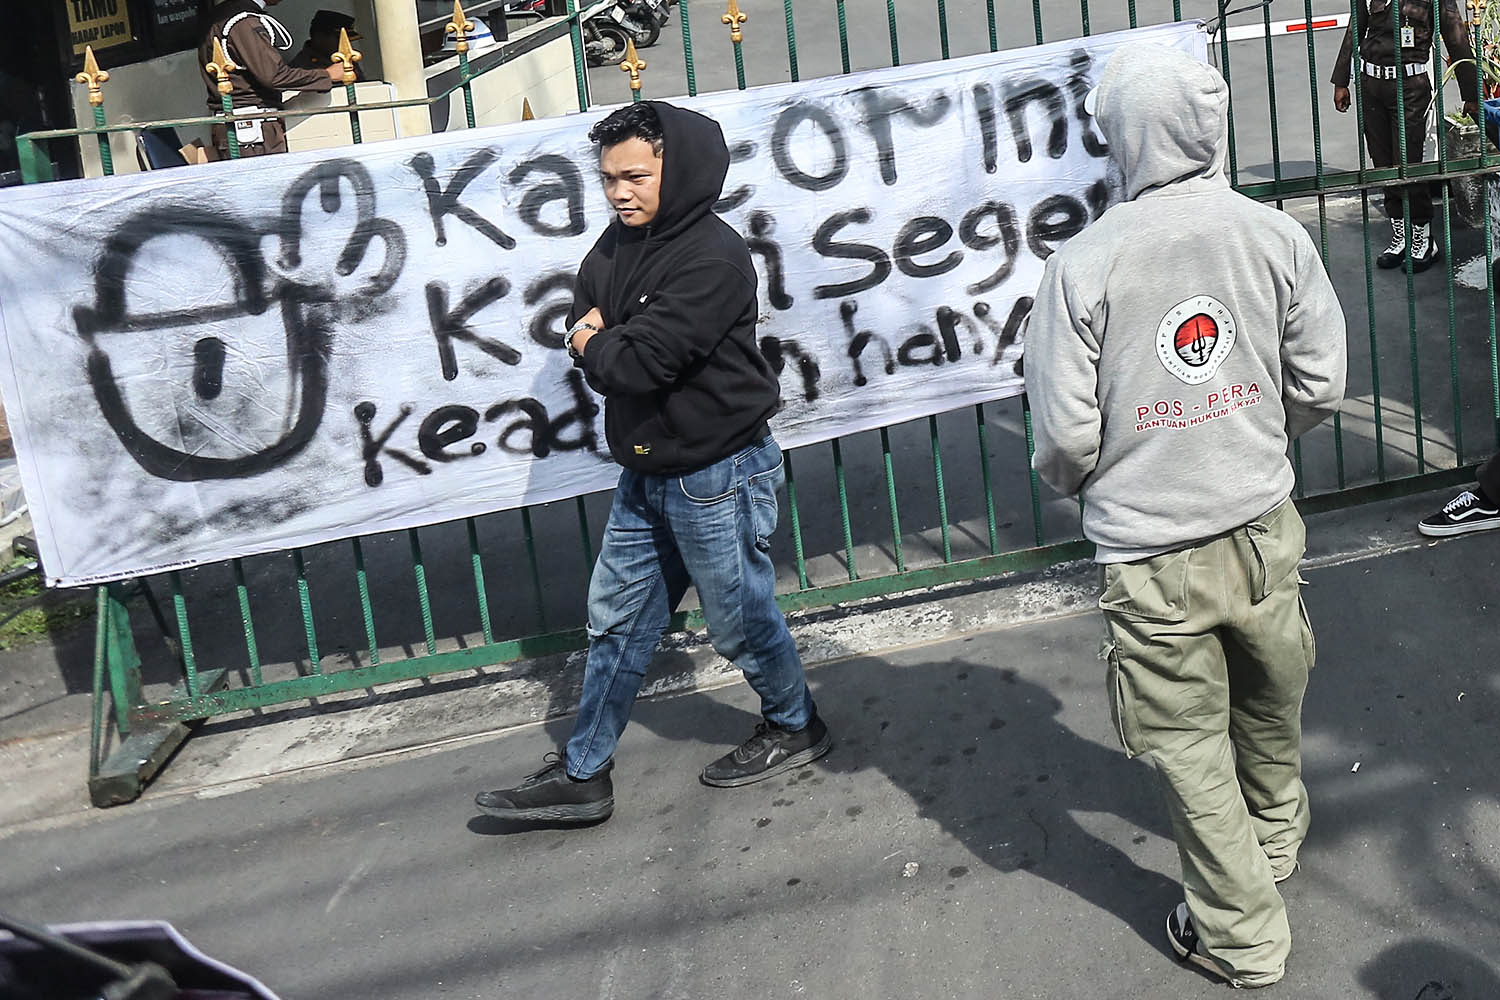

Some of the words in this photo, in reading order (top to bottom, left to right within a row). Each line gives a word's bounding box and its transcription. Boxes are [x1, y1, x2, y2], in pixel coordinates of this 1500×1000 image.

[72, 26, 100, 44] HARAP
[101, 22, 126, 40] LAPOR
[840, 296, 1034, 387] hany
[1137, 400, 1183, 420] POS
[1207, 382, 1260, 408] PERA
[1136, 419, 1186, 432] BANTUAN
[1190, 408, 1229, 425] HUKUM
